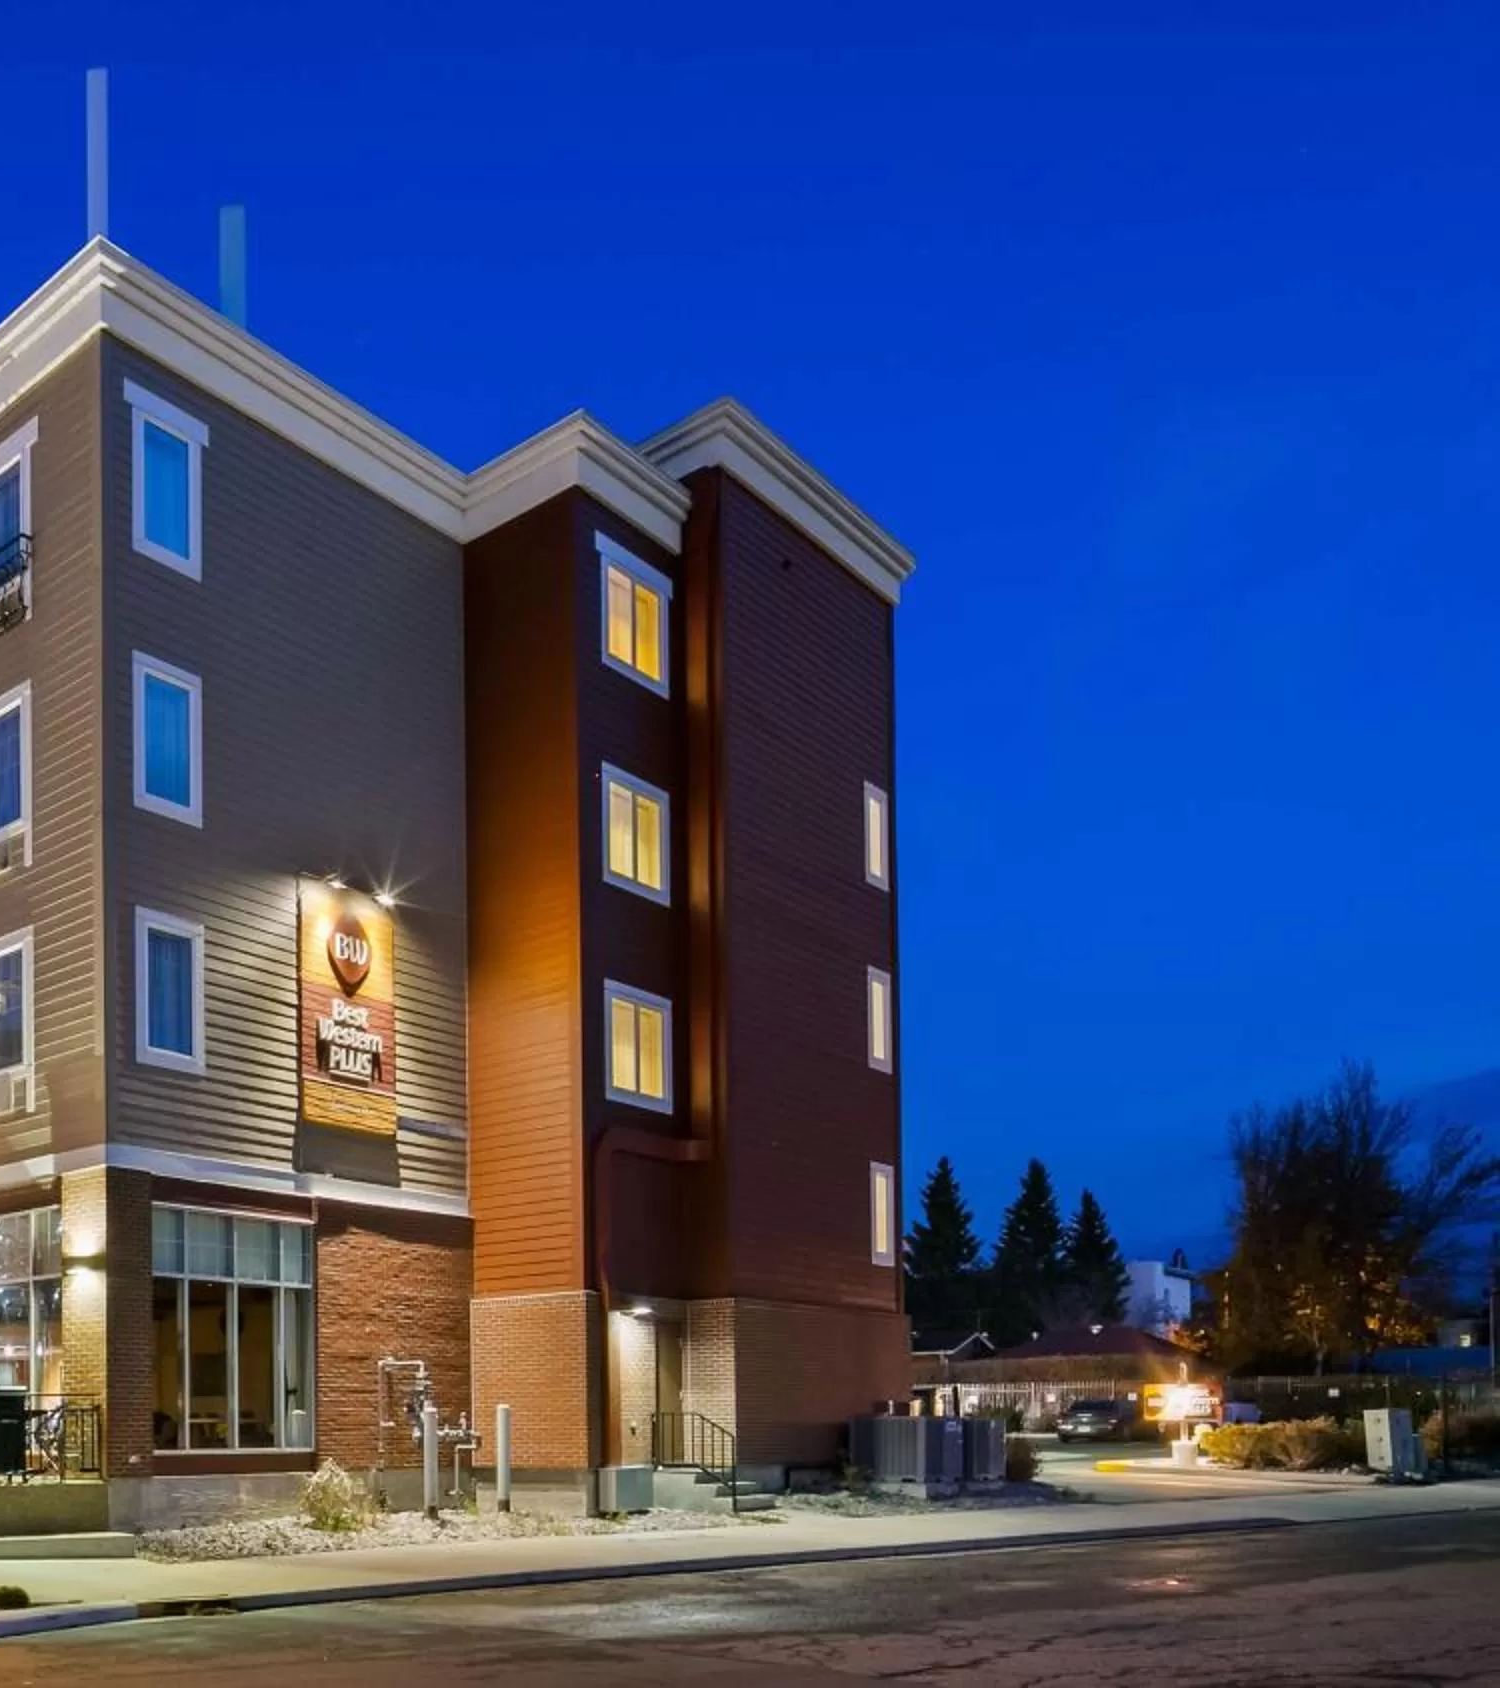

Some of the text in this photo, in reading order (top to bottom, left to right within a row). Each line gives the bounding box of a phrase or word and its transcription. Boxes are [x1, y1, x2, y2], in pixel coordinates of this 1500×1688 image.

[332, 998, 369, 1029] Best
[319, 1015, 382, 1053] Western
[329, 1045, 372, 1075] PLUS
